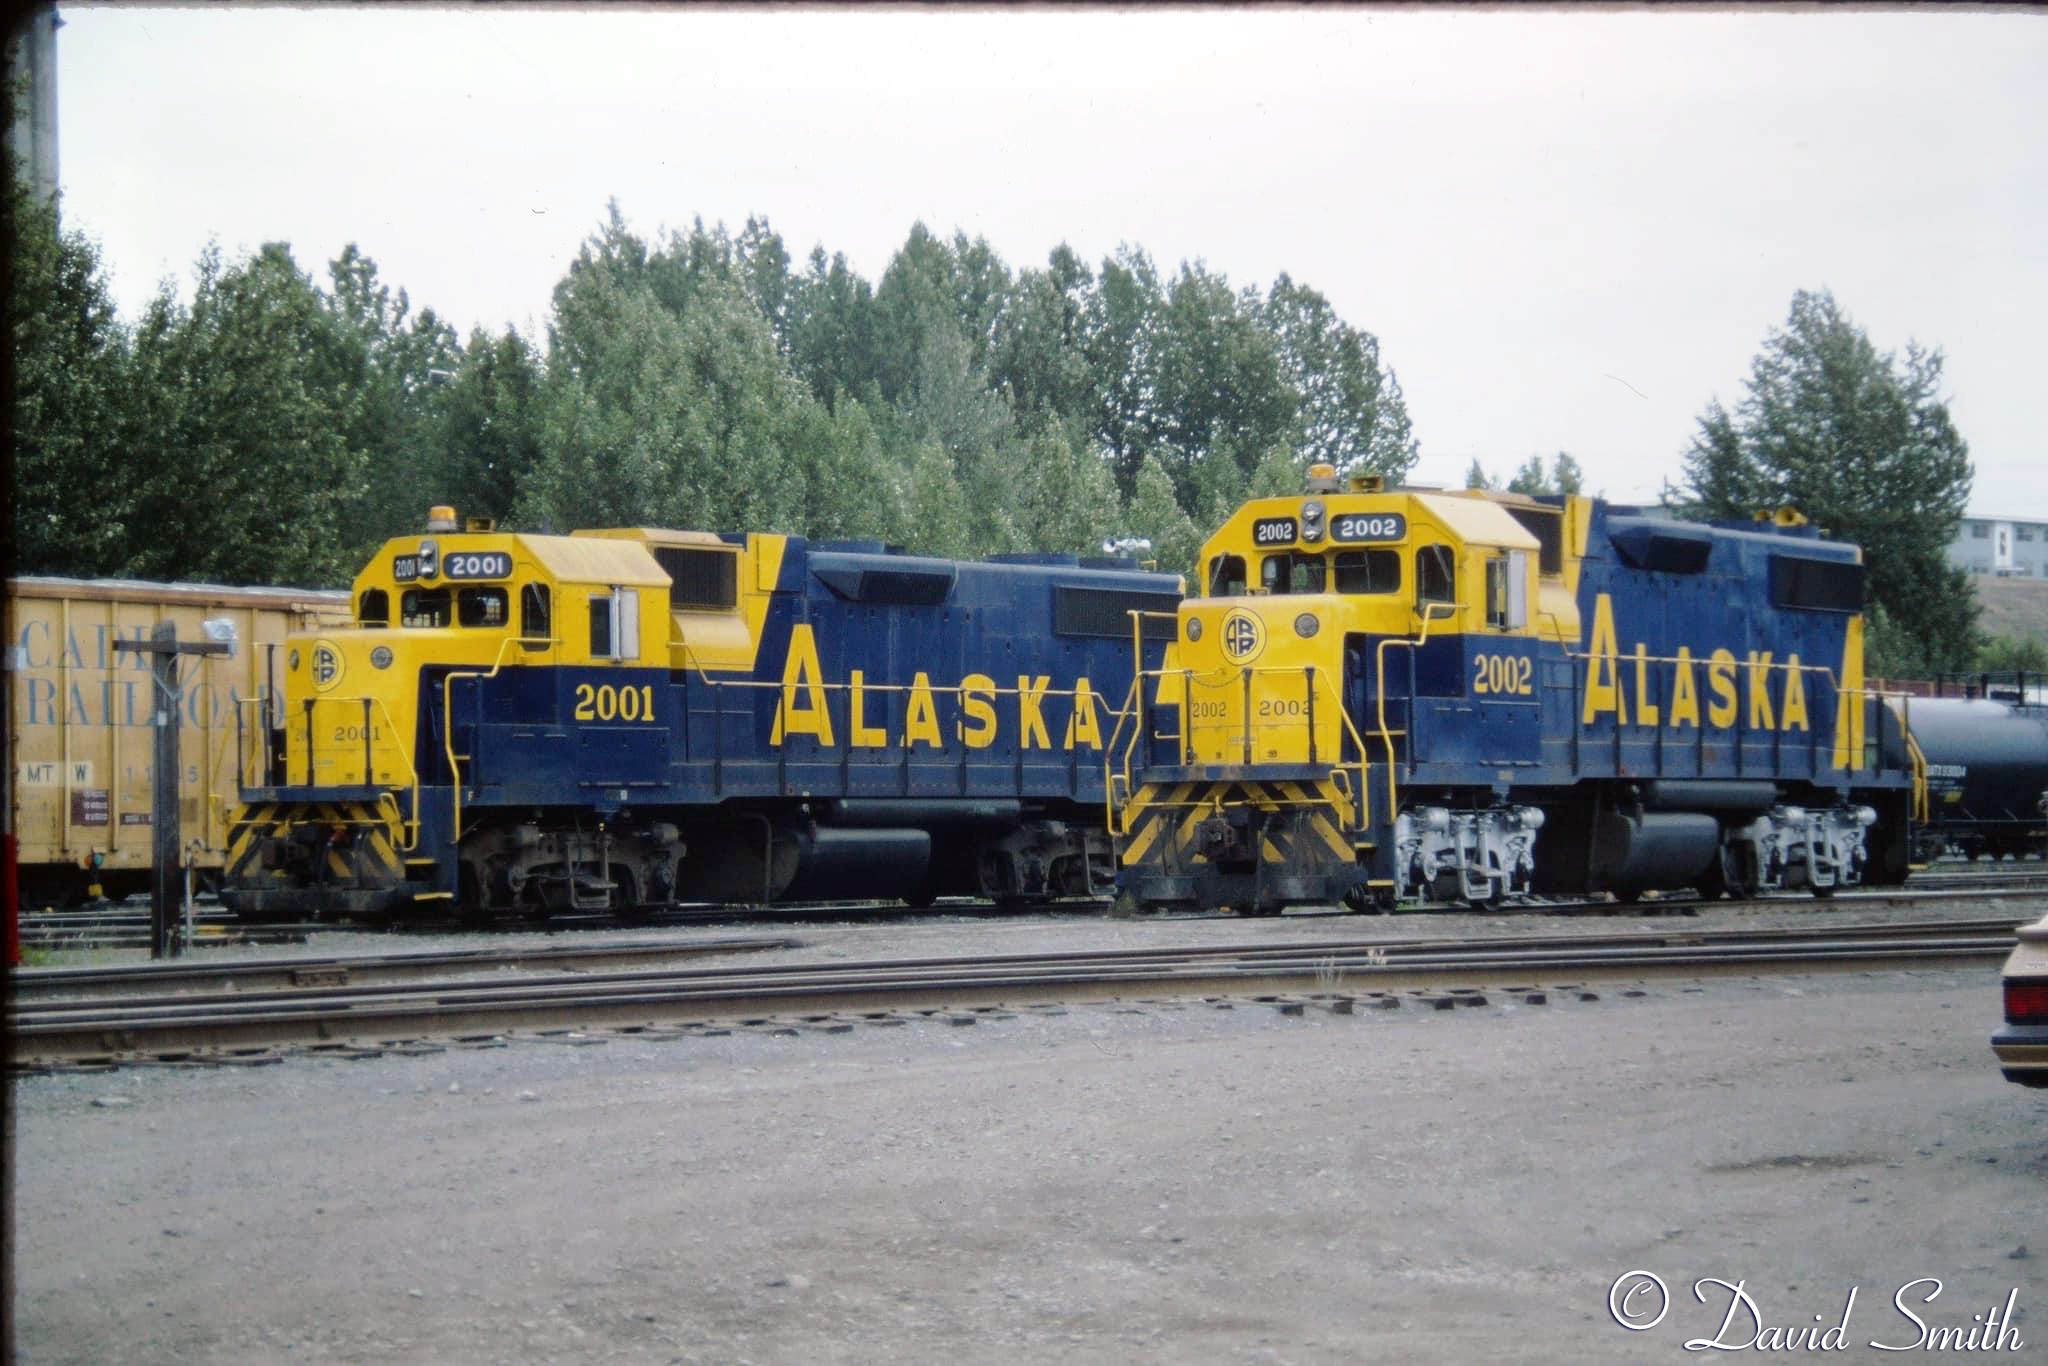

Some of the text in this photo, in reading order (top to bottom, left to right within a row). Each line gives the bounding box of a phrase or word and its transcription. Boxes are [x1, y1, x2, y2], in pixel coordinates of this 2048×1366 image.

[1258, 522, 1293, 542] 2002
[1341, 518, 1397, 537] 2002
[395, 559, 416, 577] 2001
[452, 556, 504, 575] 2001
[1582, 593, 1809, 732] ALASKA
[1473, 653, 1533, 695] 2002
[770, 623, 1103, 750] ALASKA
[575, 683, 655, 721] 2001
[1193, 702, 1227, 717] 2002
